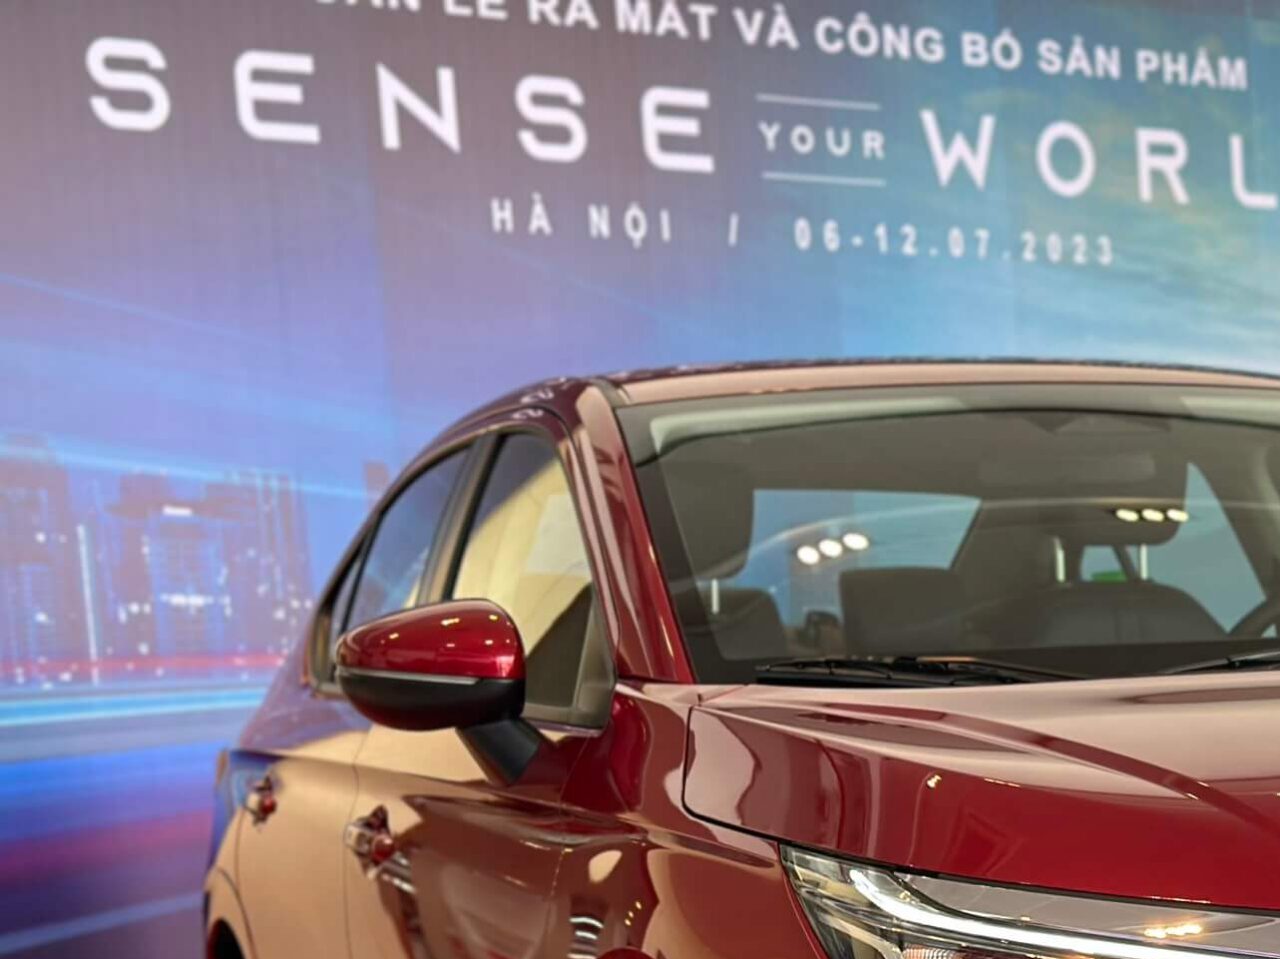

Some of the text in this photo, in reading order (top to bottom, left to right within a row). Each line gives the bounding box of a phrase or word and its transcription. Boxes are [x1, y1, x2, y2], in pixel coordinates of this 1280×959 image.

[733, 3, 800, 50] VÀ
[813, 11, 946, 63] CÔNG
[85, 36, 715, 174] SENSE
[760, 122, 885, 159] YOUR
[490, 190, 553, 236] HÀ
[587, 201, 672, 250] NỘI
[793, 216, 1116, 268] 06-12.07.2023
